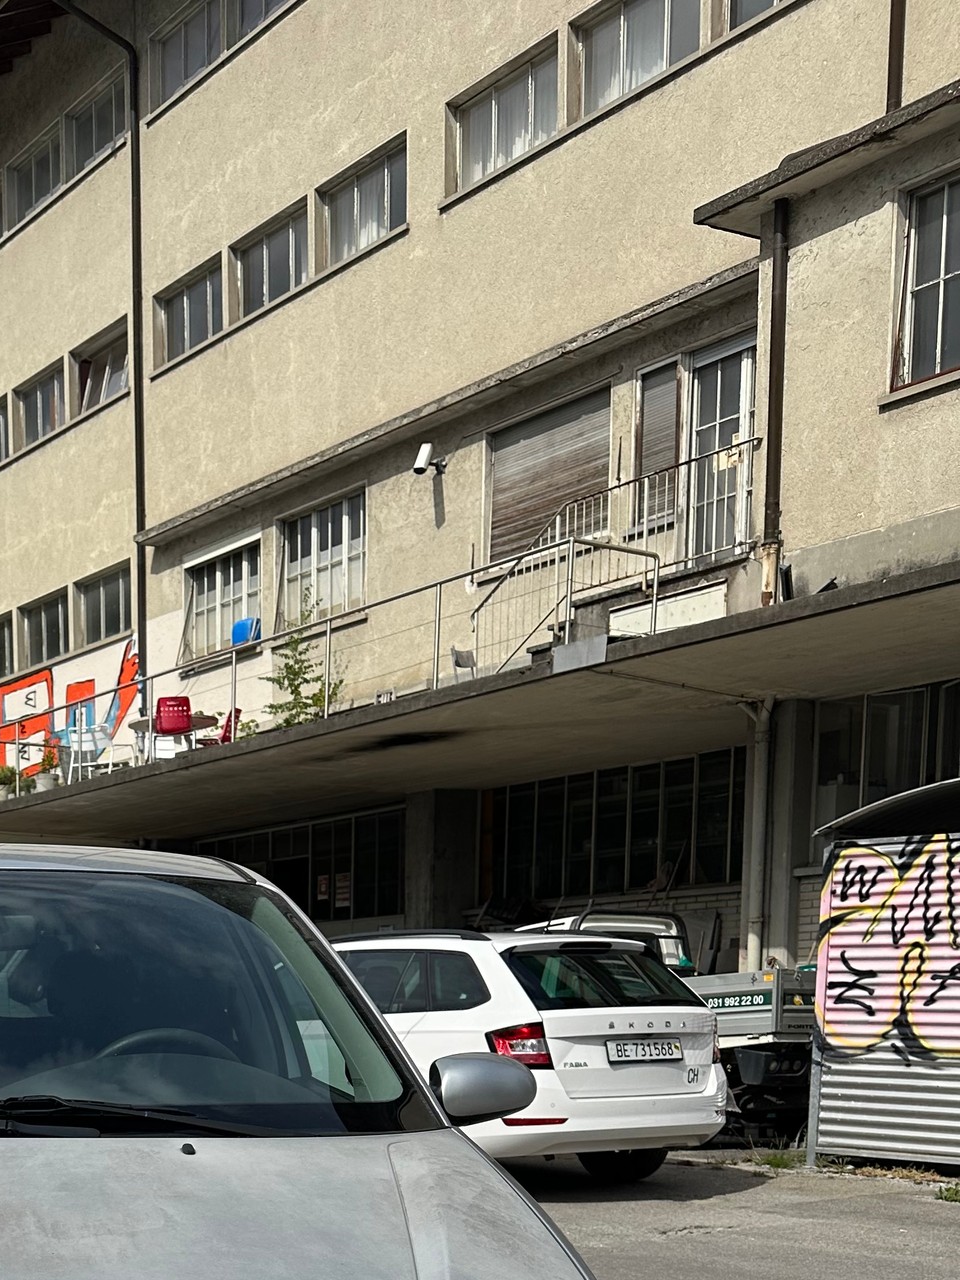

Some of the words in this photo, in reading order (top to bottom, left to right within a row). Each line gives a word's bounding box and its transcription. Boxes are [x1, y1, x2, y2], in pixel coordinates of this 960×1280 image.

[708, 998, 723, 1008] 031
[724, 996, 740, 1007] 992
[741, 995, 752, 1006] 22
[753, 995, 764, 1005] 00
[687, 1068, 699, 1084] CH
